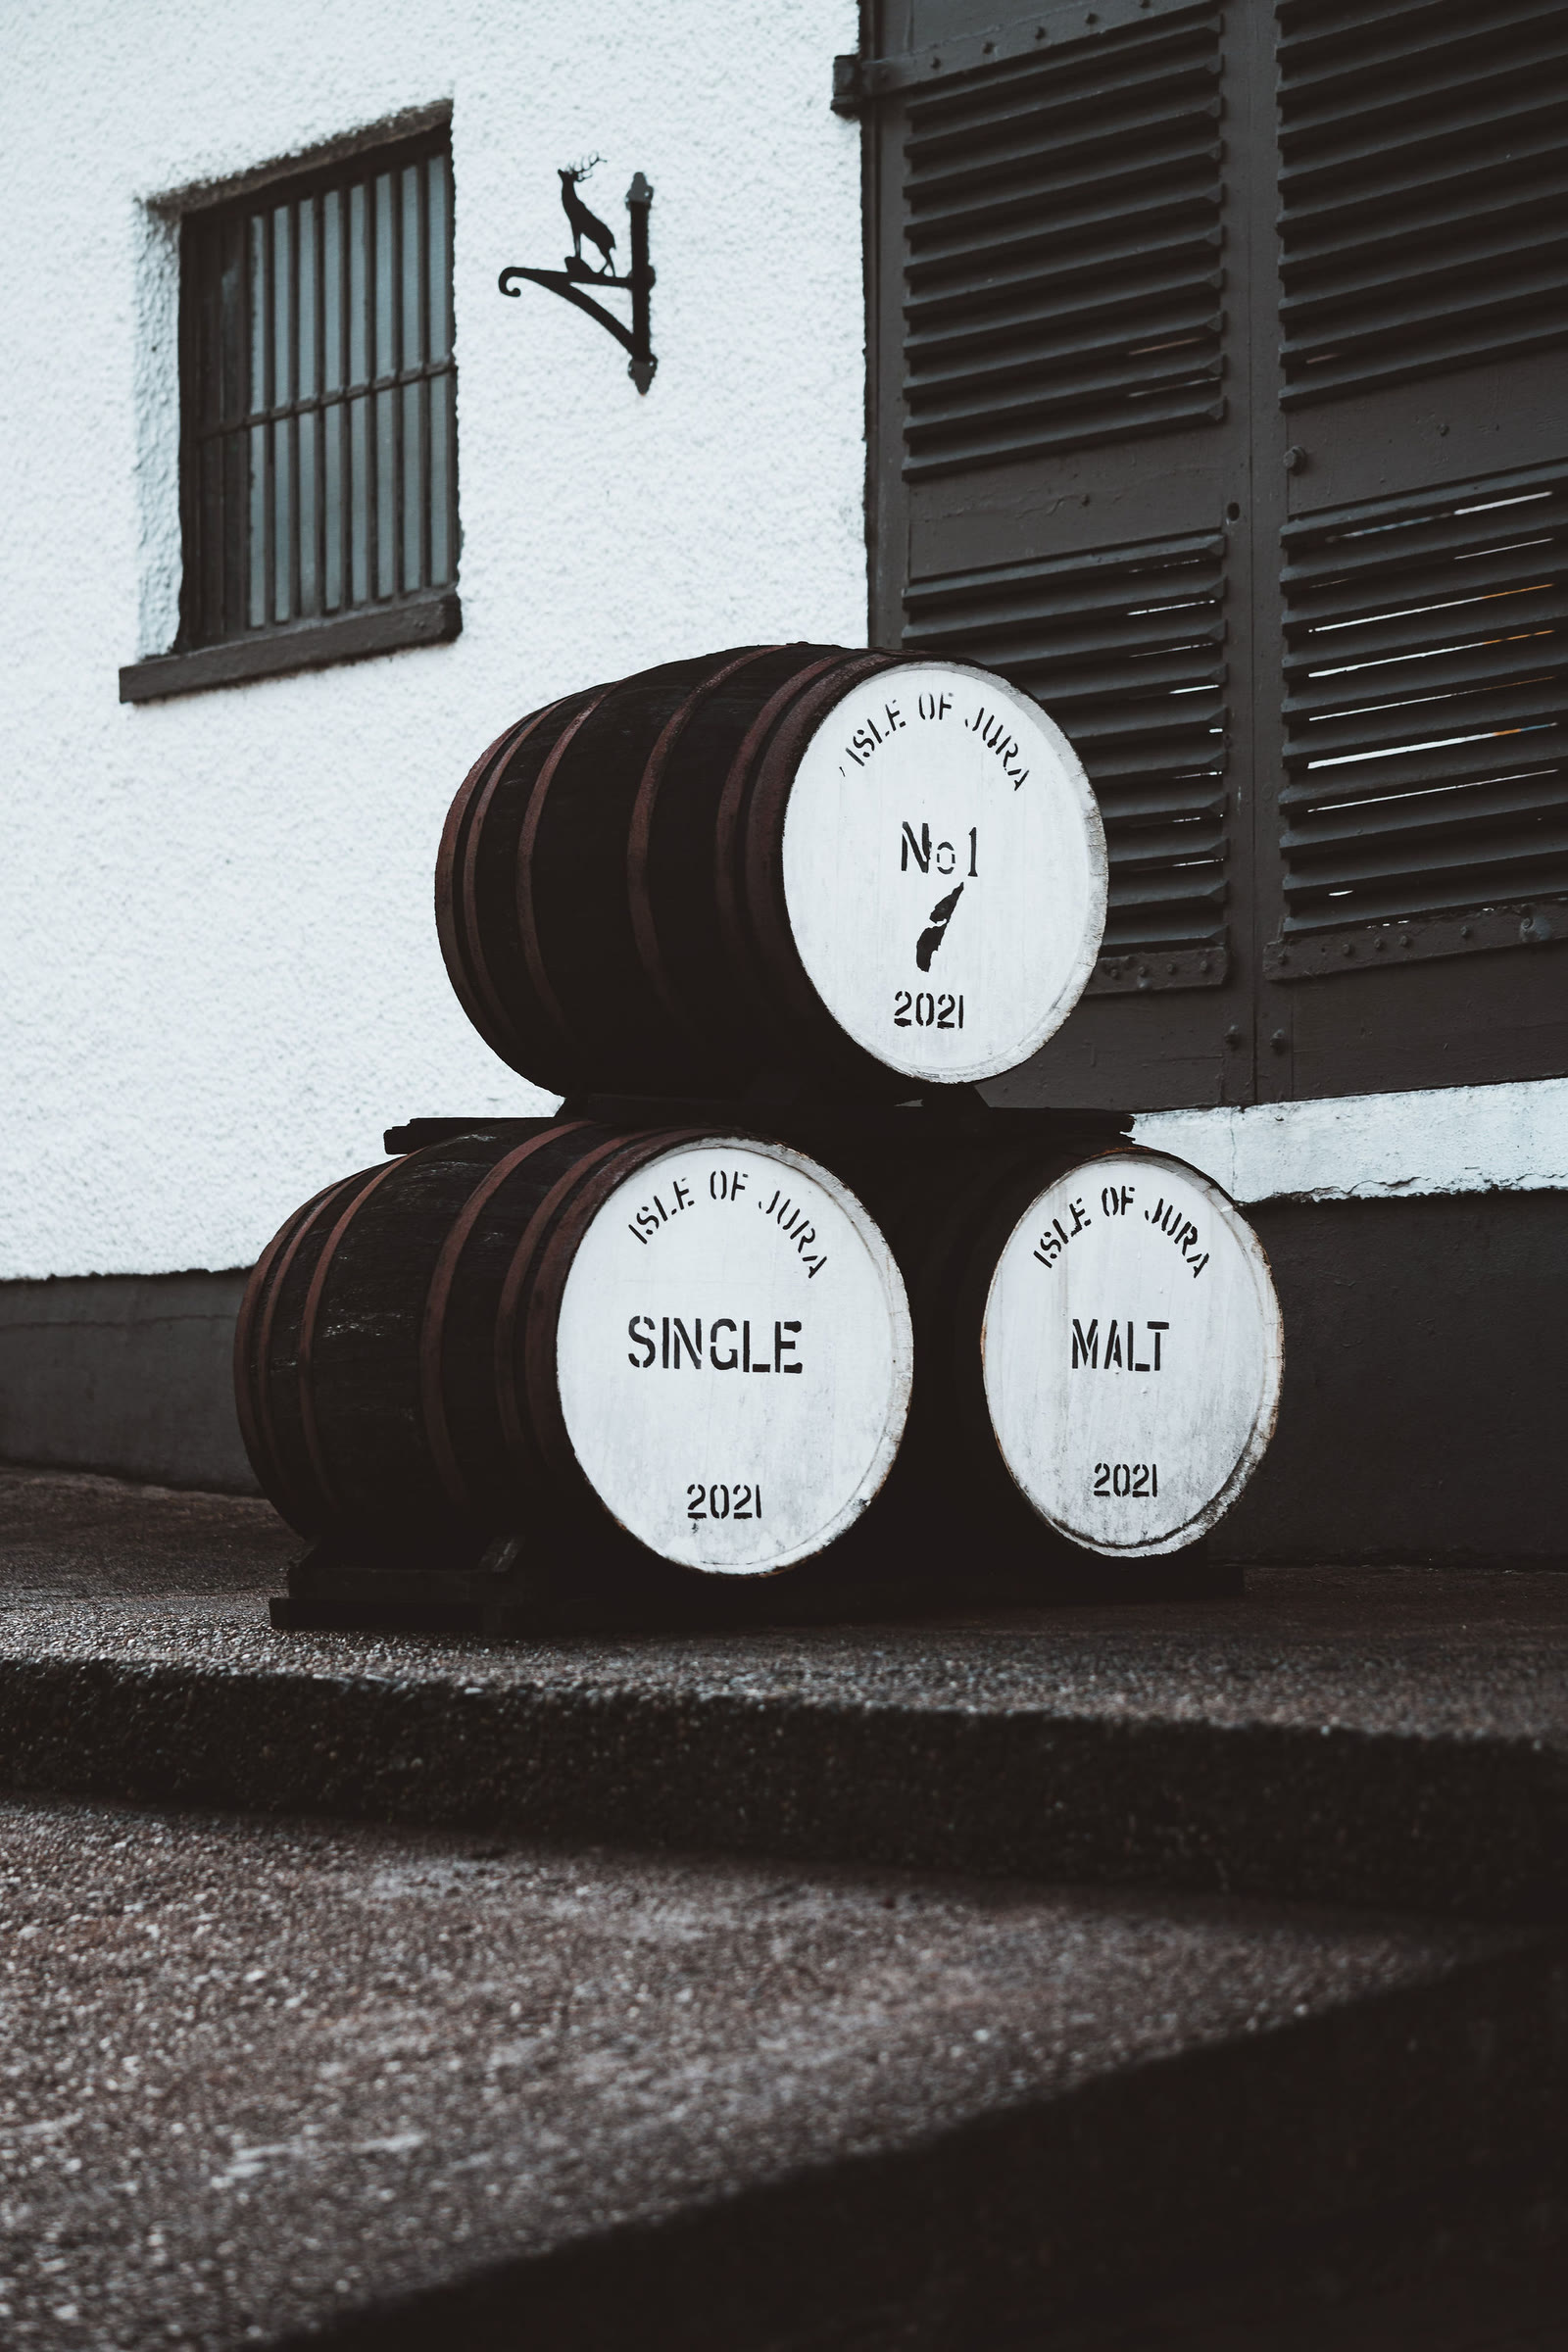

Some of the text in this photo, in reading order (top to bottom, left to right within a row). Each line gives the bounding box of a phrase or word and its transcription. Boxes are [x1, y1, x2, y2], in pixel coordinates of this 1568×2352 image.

[845, 691, 1030, 792] ISLE OF JURA
[894, 990, 964, 1029] 2021
[628, 1170, 828, 1279] ISLE OF JURA
[1033, 1186, 1210, 1279] ISLE OF JURA
[627, 1315, 804, 1375] SINGLE
[1071, 1318, 1170, 1372] MALT
[686, 1484, 762, 1520] 2021
[1093, 1462, 1158, 1498] 2021
